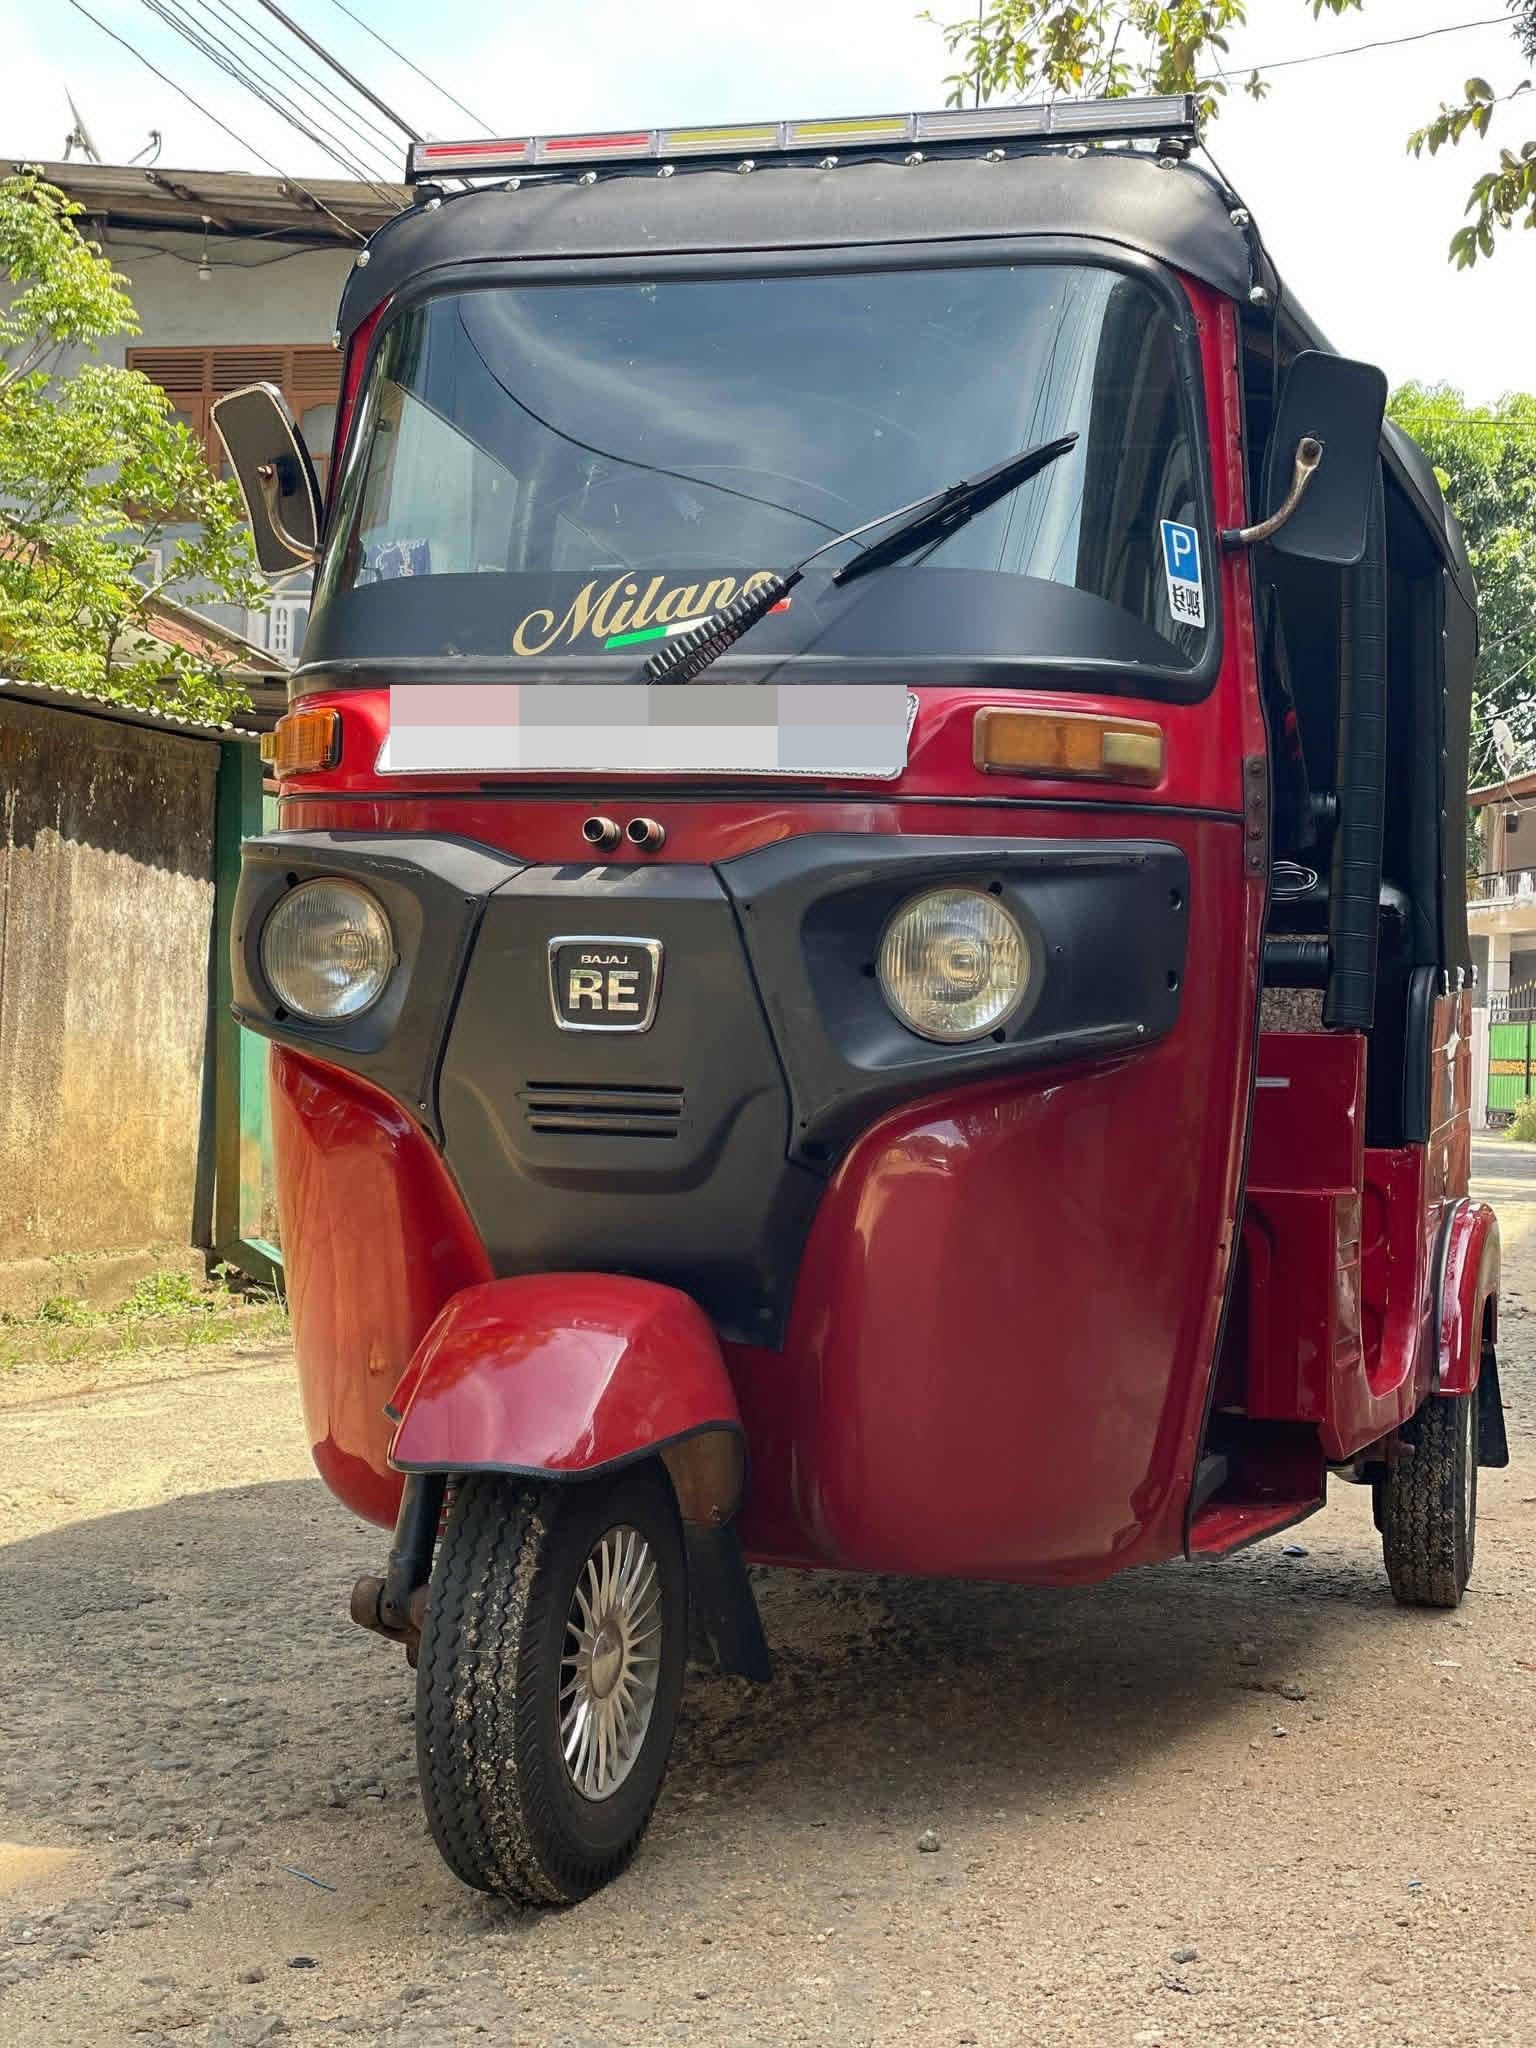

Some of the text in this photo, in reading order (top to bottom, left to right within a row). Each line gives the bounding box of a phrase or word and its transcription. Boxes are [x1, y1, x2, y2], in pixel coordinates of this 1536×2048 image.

[1171, 529, 1191, 567] P
[580, 955, 629, 965] BAJAJ
[568, 968, 640, 1011] RE
